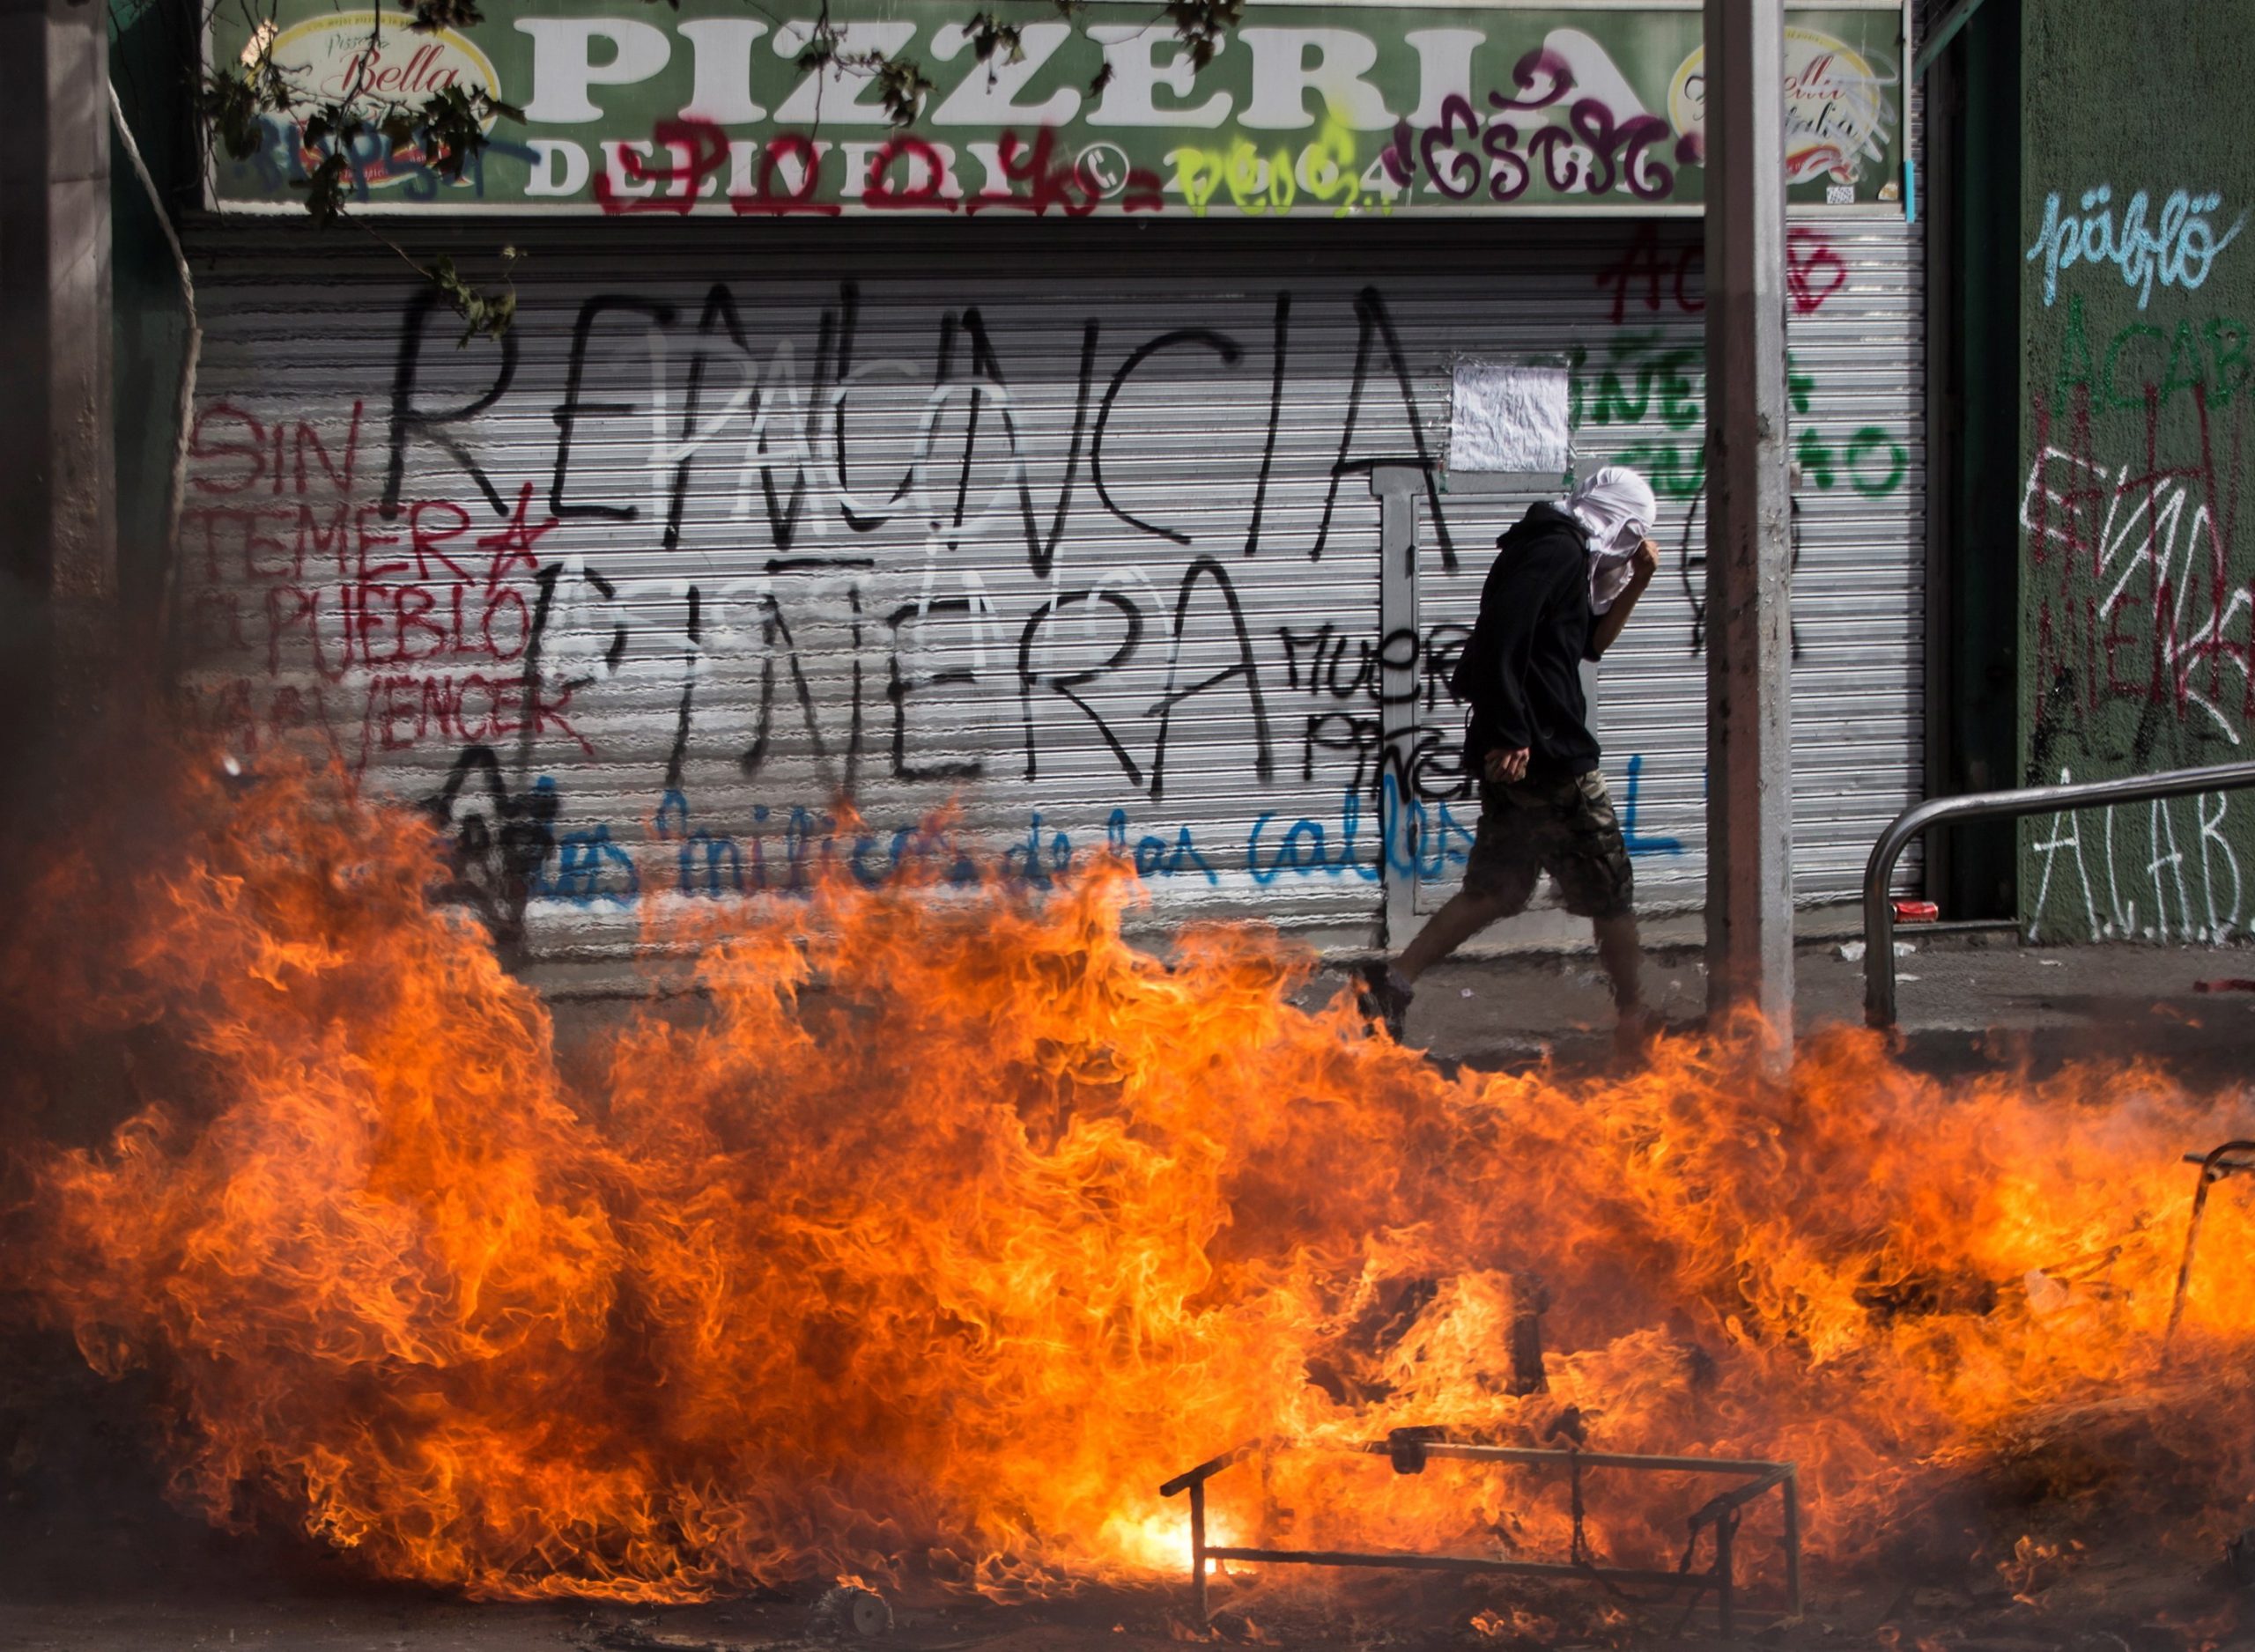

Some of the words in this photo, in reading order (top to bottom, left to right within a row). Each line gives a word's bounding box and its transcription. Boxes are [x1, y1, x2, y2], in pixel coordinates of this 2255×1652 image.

[514, 18, 1656, 130] PIZZERIA
[524, 139, 1029, 197] DELIVERY
[189, 396, 363, 496] SIN
[266, 581, 530, 686] PUEBLO
